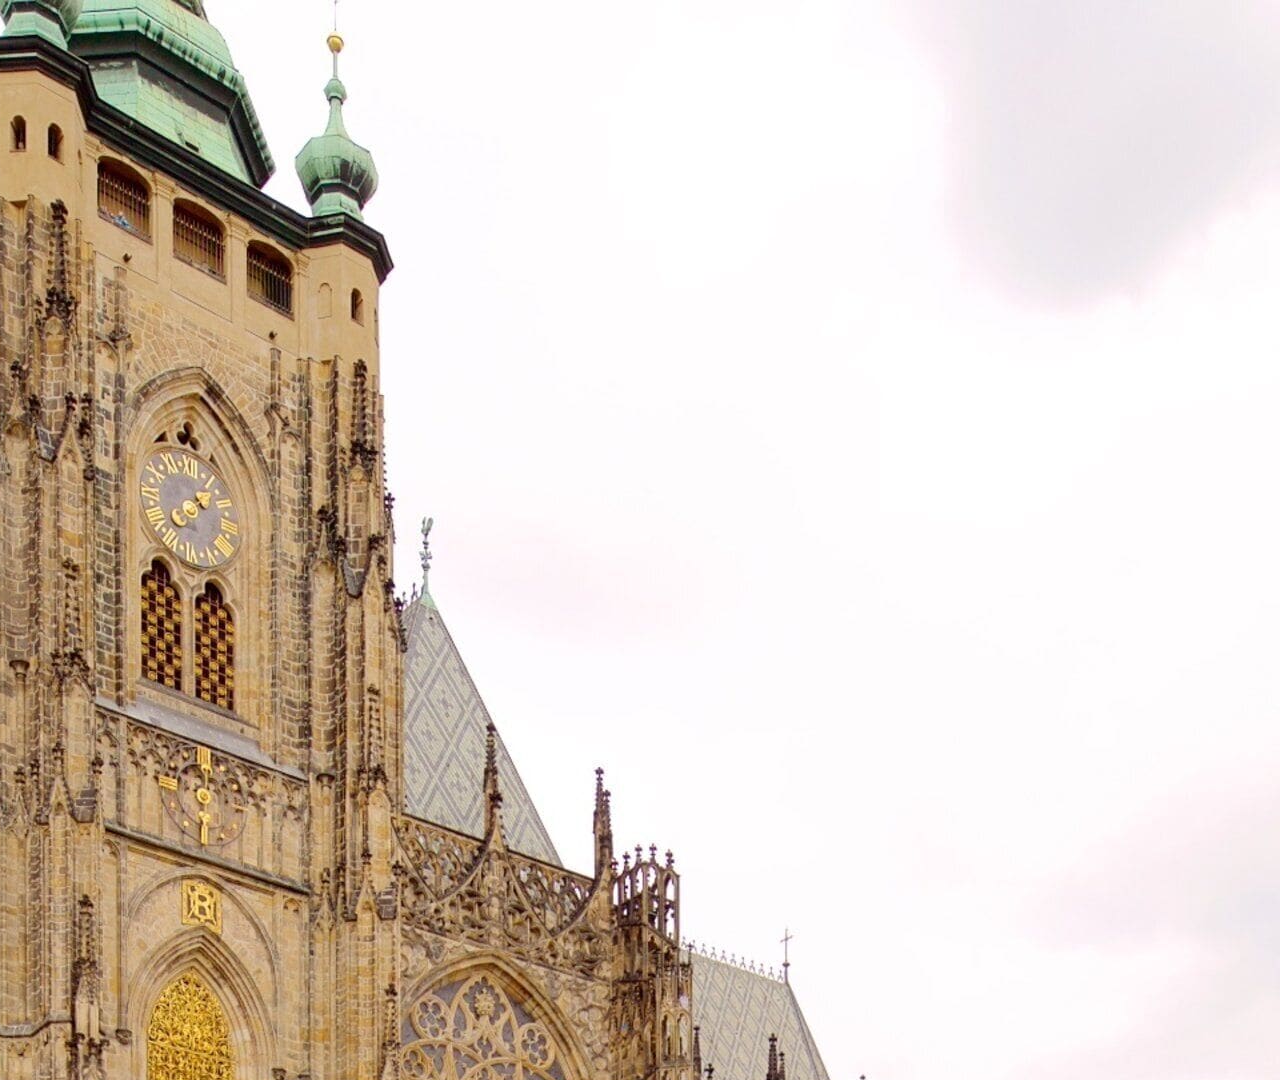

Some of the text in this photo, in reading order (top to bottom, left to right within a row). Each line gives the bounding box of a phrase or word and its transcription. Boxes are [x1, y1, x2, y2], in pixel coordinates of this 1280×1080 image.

[145, 461, 166, 483] X
[182, 454, 198, 479] XII
[215, 499, 233, 509] II
[221, 517, 239, 535] III
